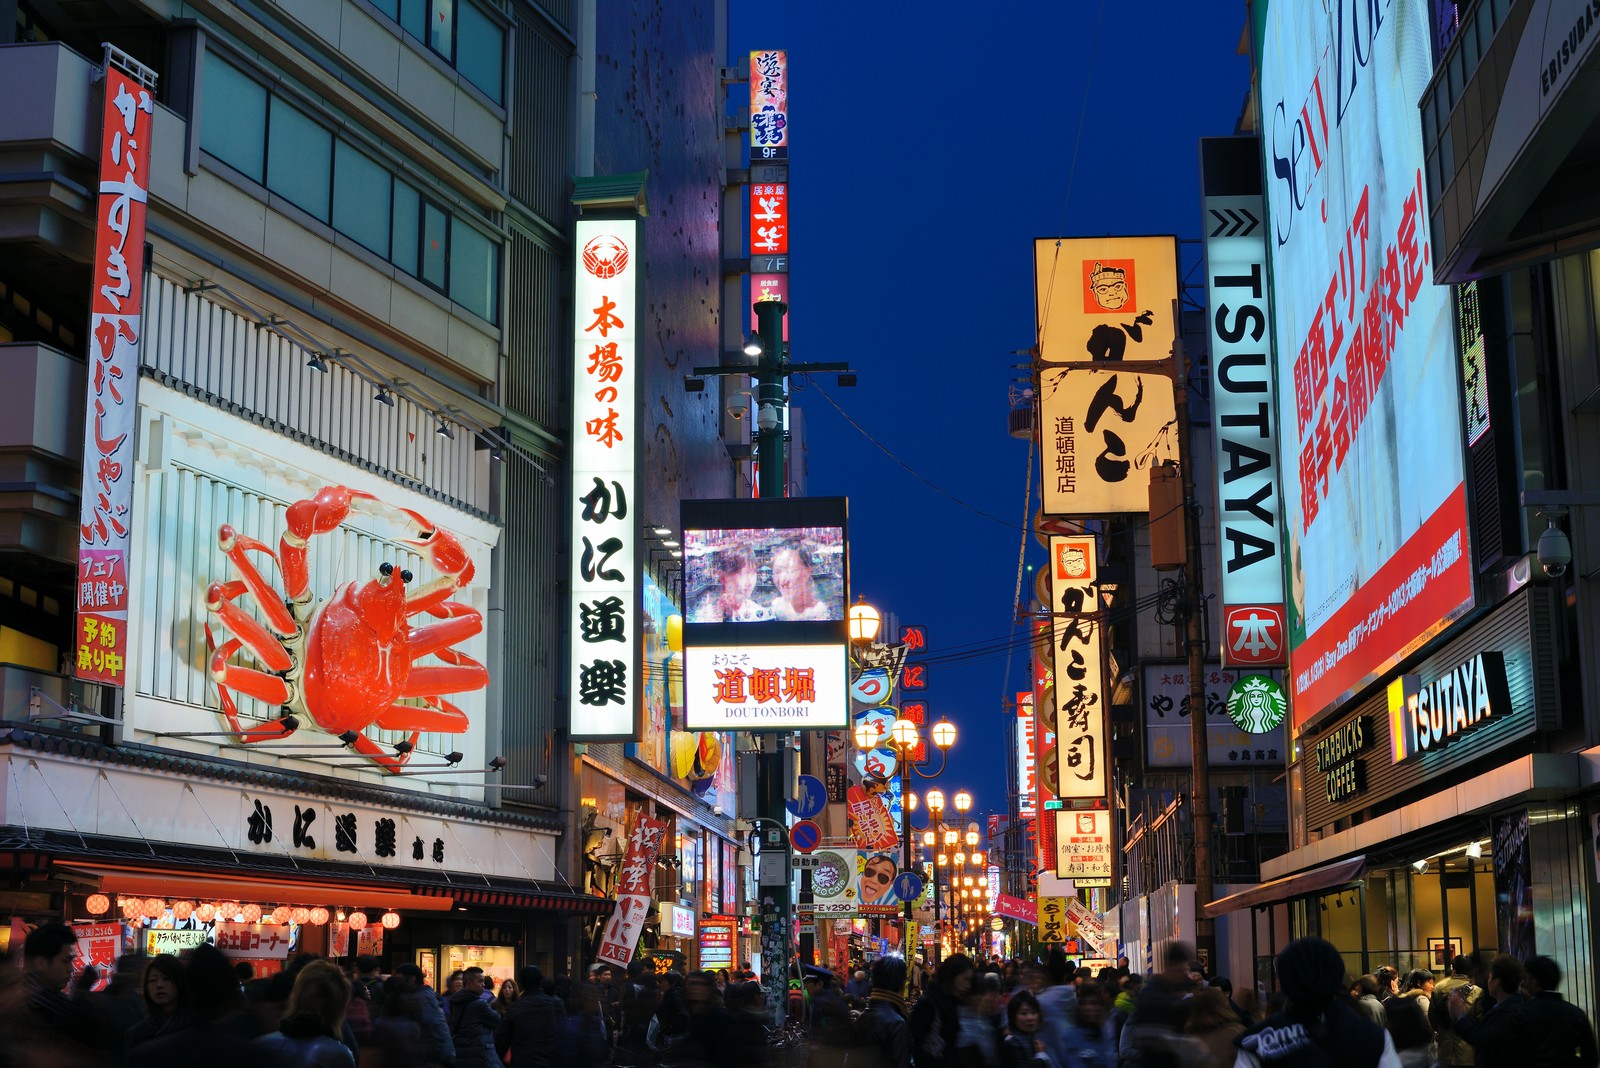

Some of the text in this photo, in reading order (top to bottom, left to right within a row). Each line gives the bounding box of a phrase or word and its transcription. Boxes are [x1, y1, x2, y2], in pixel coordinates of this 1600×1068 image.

[762, 147, 777, 158] 9F
[100, 82, 153, 312] かにすき
[765, 258, 786, 271] 7F
[1293, 184, 1369, 445] 関西エリア
[584, 295, 625, 450] 本場の味
[1213, 263, 1276, 574] TSUTAYA
[1055, 416, 1076, 494] 道頓堀店
[81, 553, 121, 579] フェア
[80, 580, 124, 608] 開催中
[83, 617, 117, 649] 予約
[1232, 612, 1278, 658] 本
[77, 644, 124, 678] 承り中
[711, 653, 750, 666] ようこそ
[713, 667, 816, 704] 道頓堀
[725, 707, 810, 719] DOUTONBORI
[1408, 653, 1492, 753] TSUTAYA
[1316, 715, 1363, 773] STARBUCKS
[1325, 759, 1356, 803] COFFEE
[792, 857, 820, 867] 自動車
[846, 889, 857, 898] 2F
[217, 929, 289, 952] お土産コーナー
[605, 945, 629, 961] 入荷
